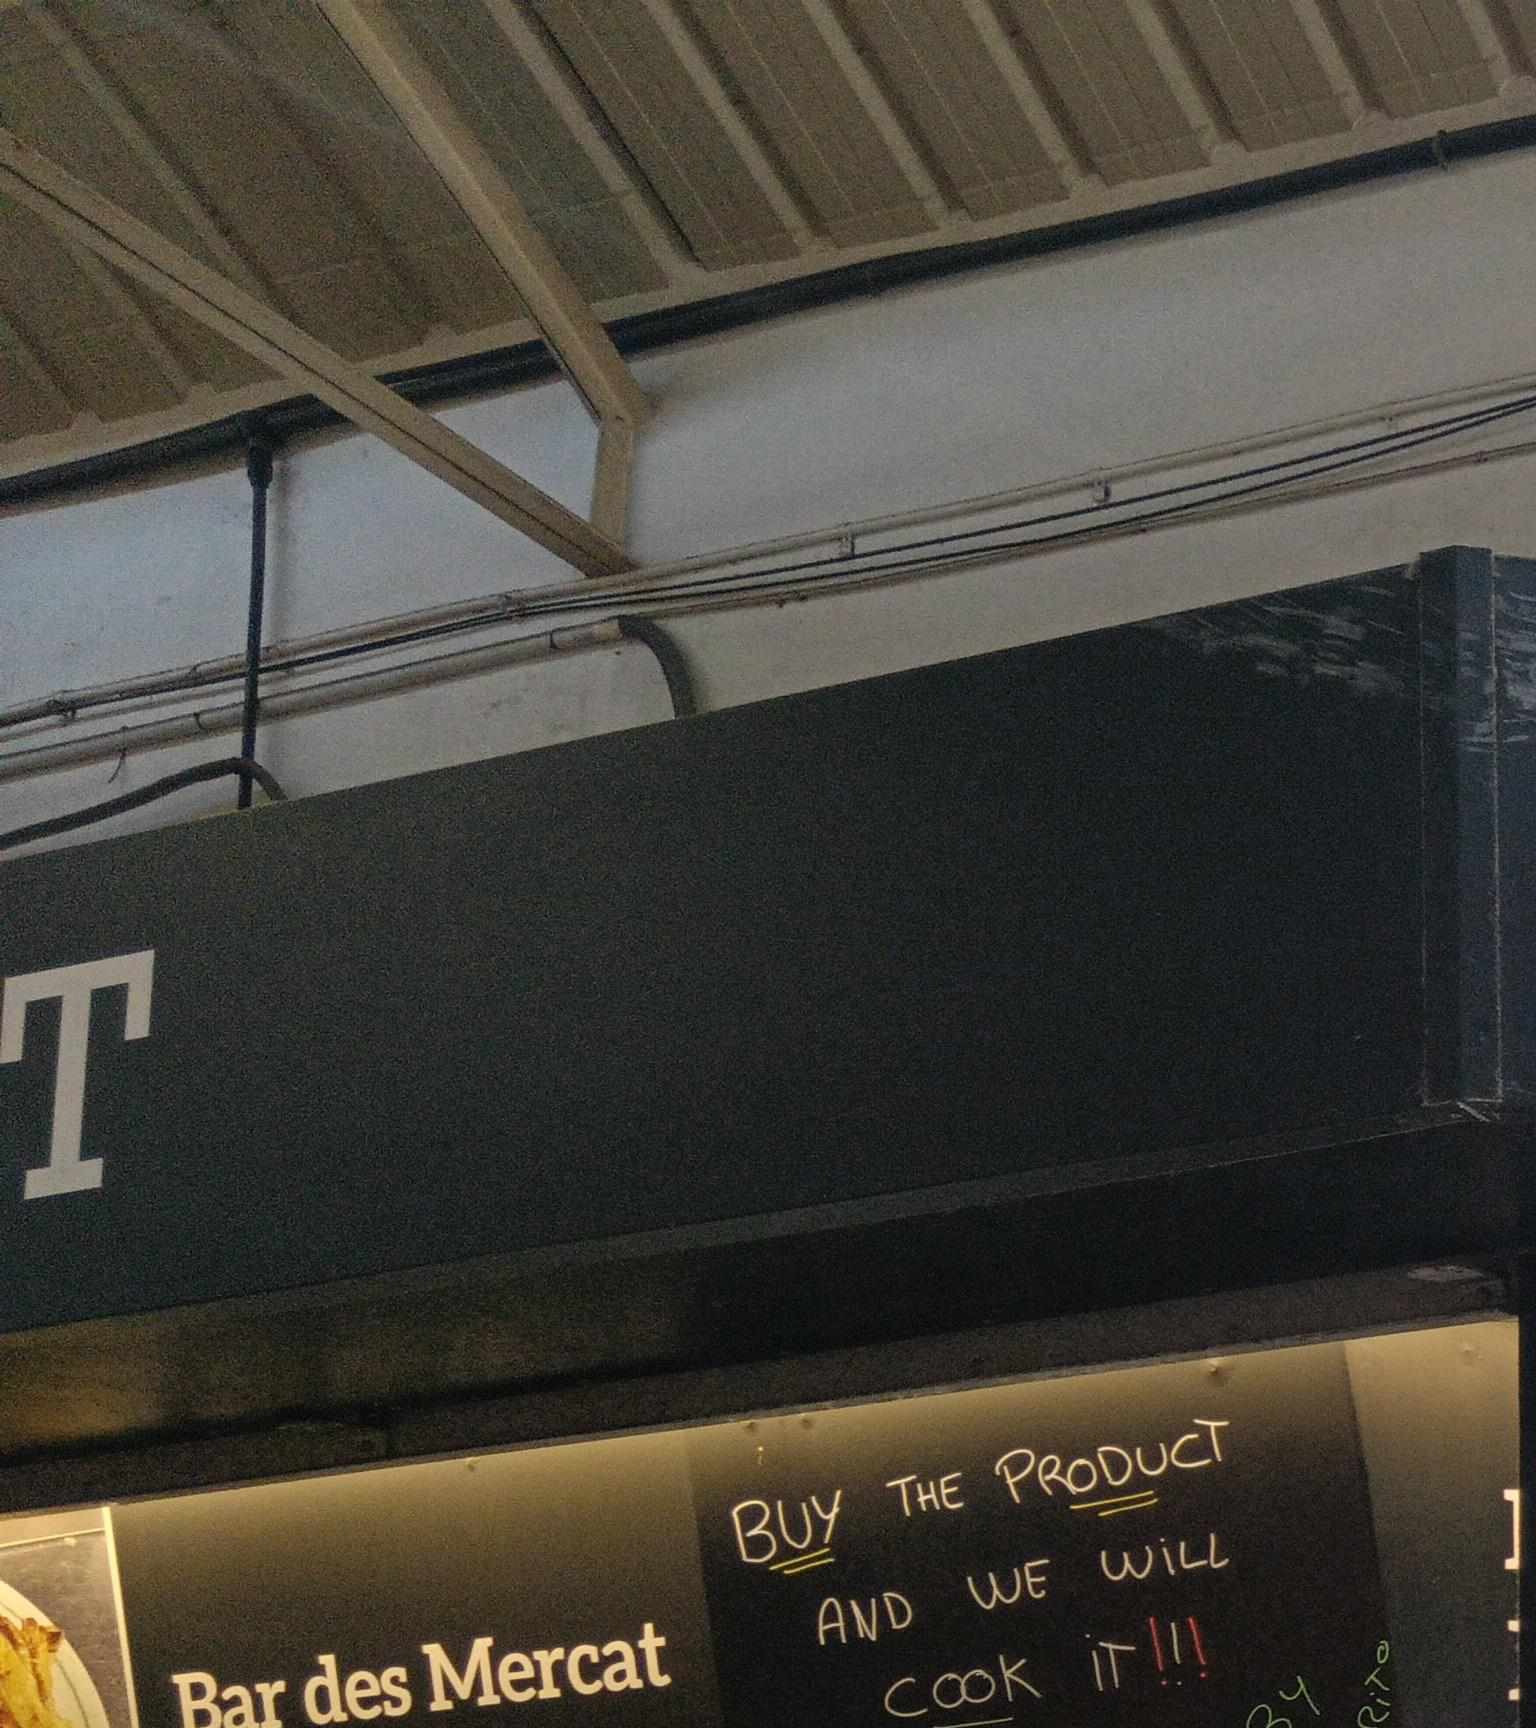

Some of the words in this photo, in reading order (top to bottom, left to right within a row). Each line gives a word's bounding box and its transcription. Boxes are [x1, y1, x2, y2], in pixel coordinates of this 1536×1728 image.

[731, 1490, 842, 1563] BUY
[886, 1471, 966, 1517] THE
[994, 1418, 1231, 1504] PRODUCT
[816, 1591, 913, 1646] AND
[966, 1559, 1051, 1612] WE
[304, 1653, 412, 1726] des
[421, 1622, 673, 1712] Mercat
[884, 1653, 1043, 1719] COOK
